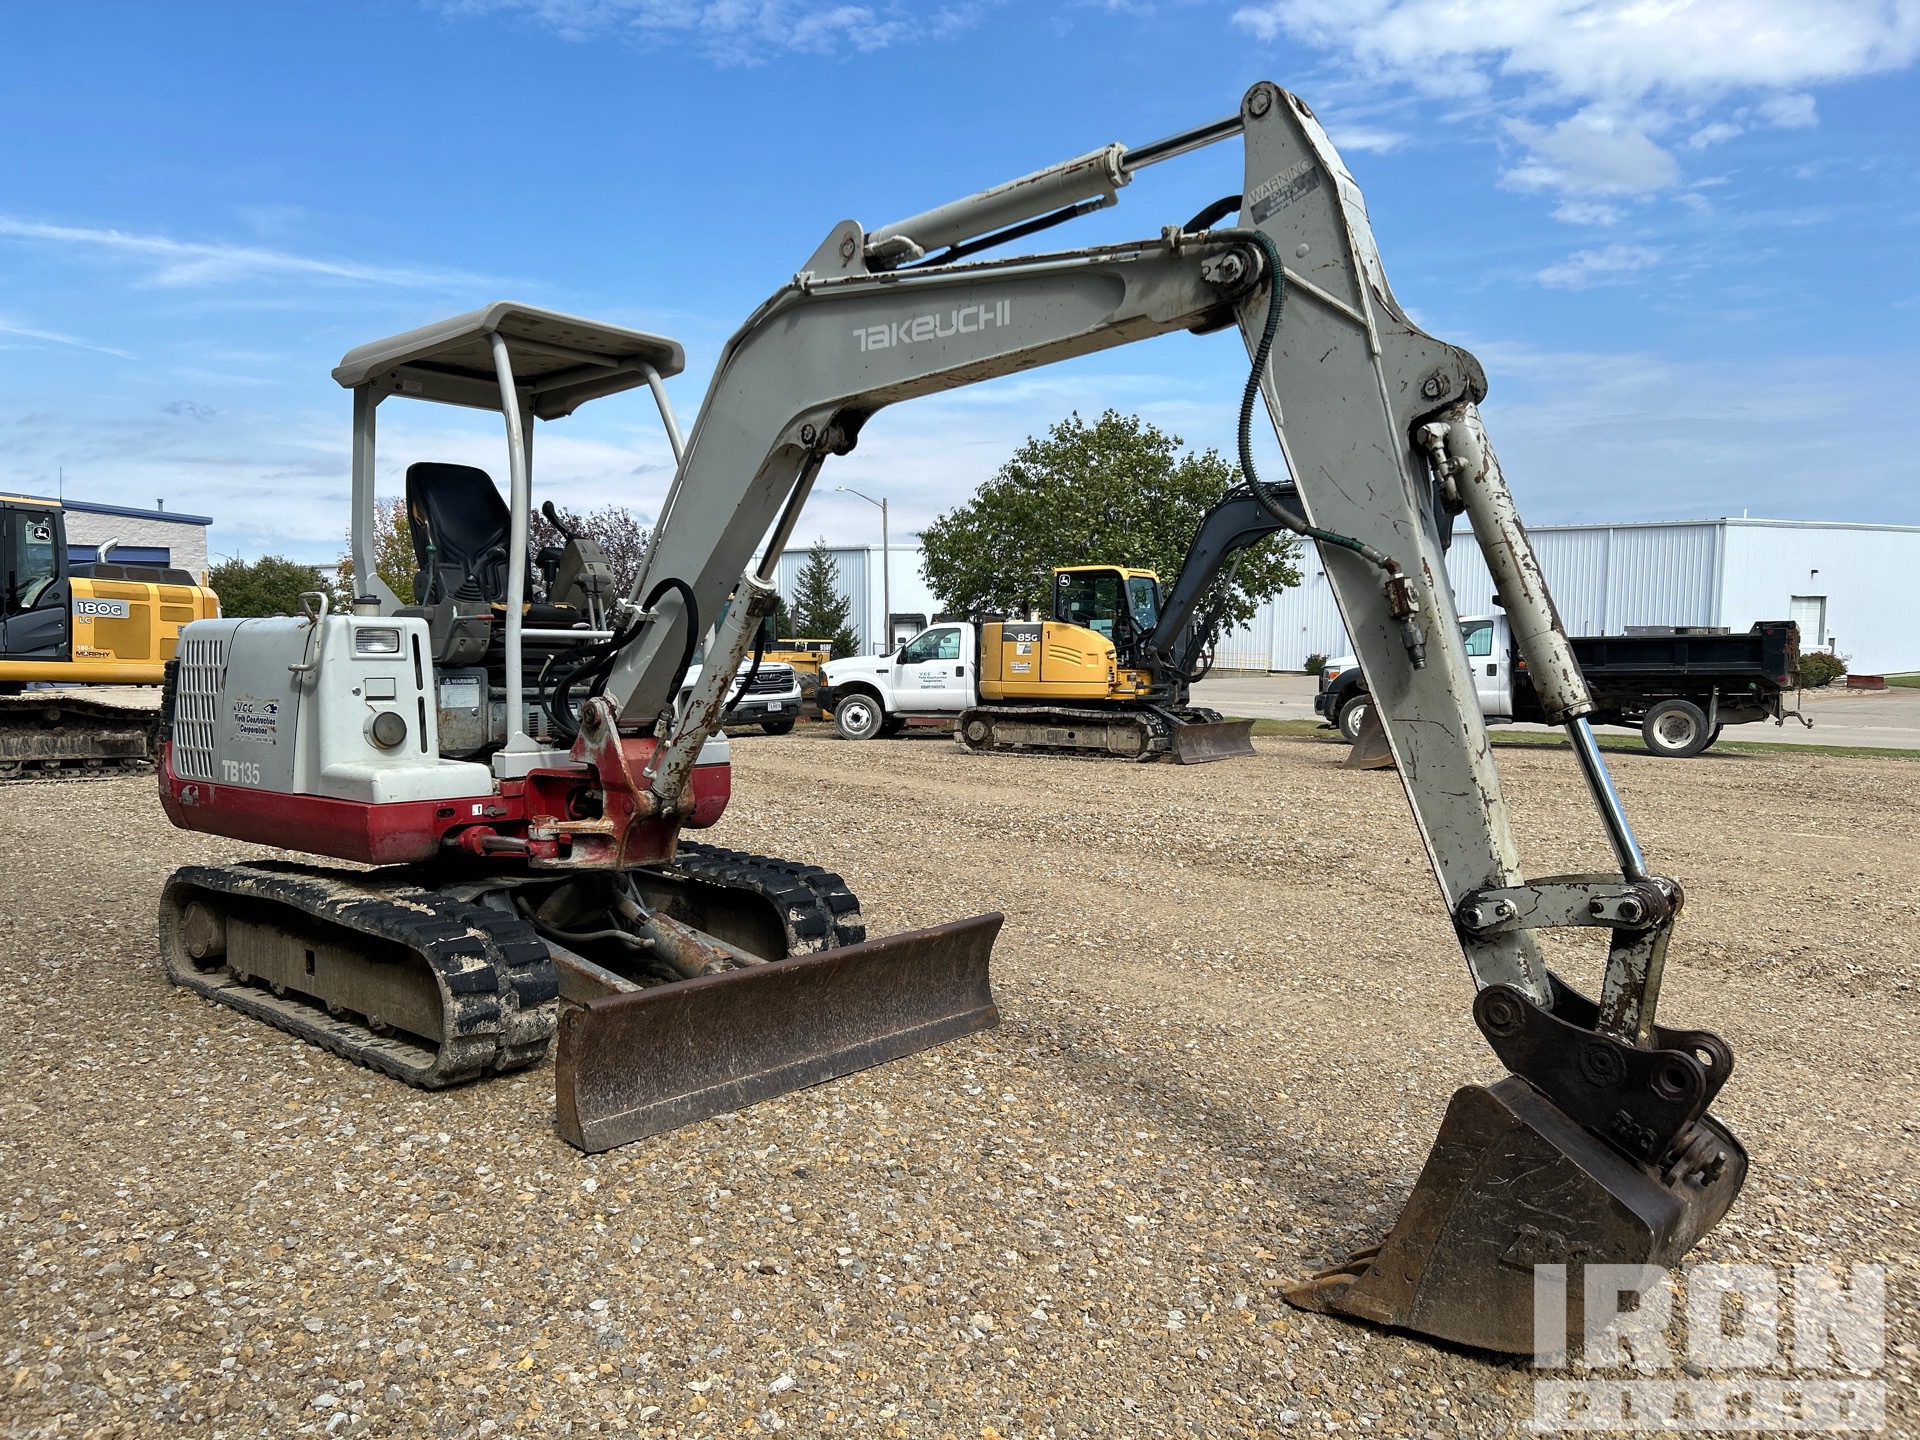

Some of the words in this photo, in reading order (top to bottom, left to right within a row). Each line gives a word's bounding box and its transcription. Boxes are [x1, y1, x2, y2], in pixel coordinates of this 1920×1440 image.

[1250, 159, 1310, 202] WARNING
[1270, 191, 1279, 200] DO
[1280, 182, 1295, 194] NOT
[77, 601, 122, 616] 180G
[1017, 633, 1038, 642] 85G
[1046, 631, 1051, 640] 1
[222, 759, 260, 785] TB135
